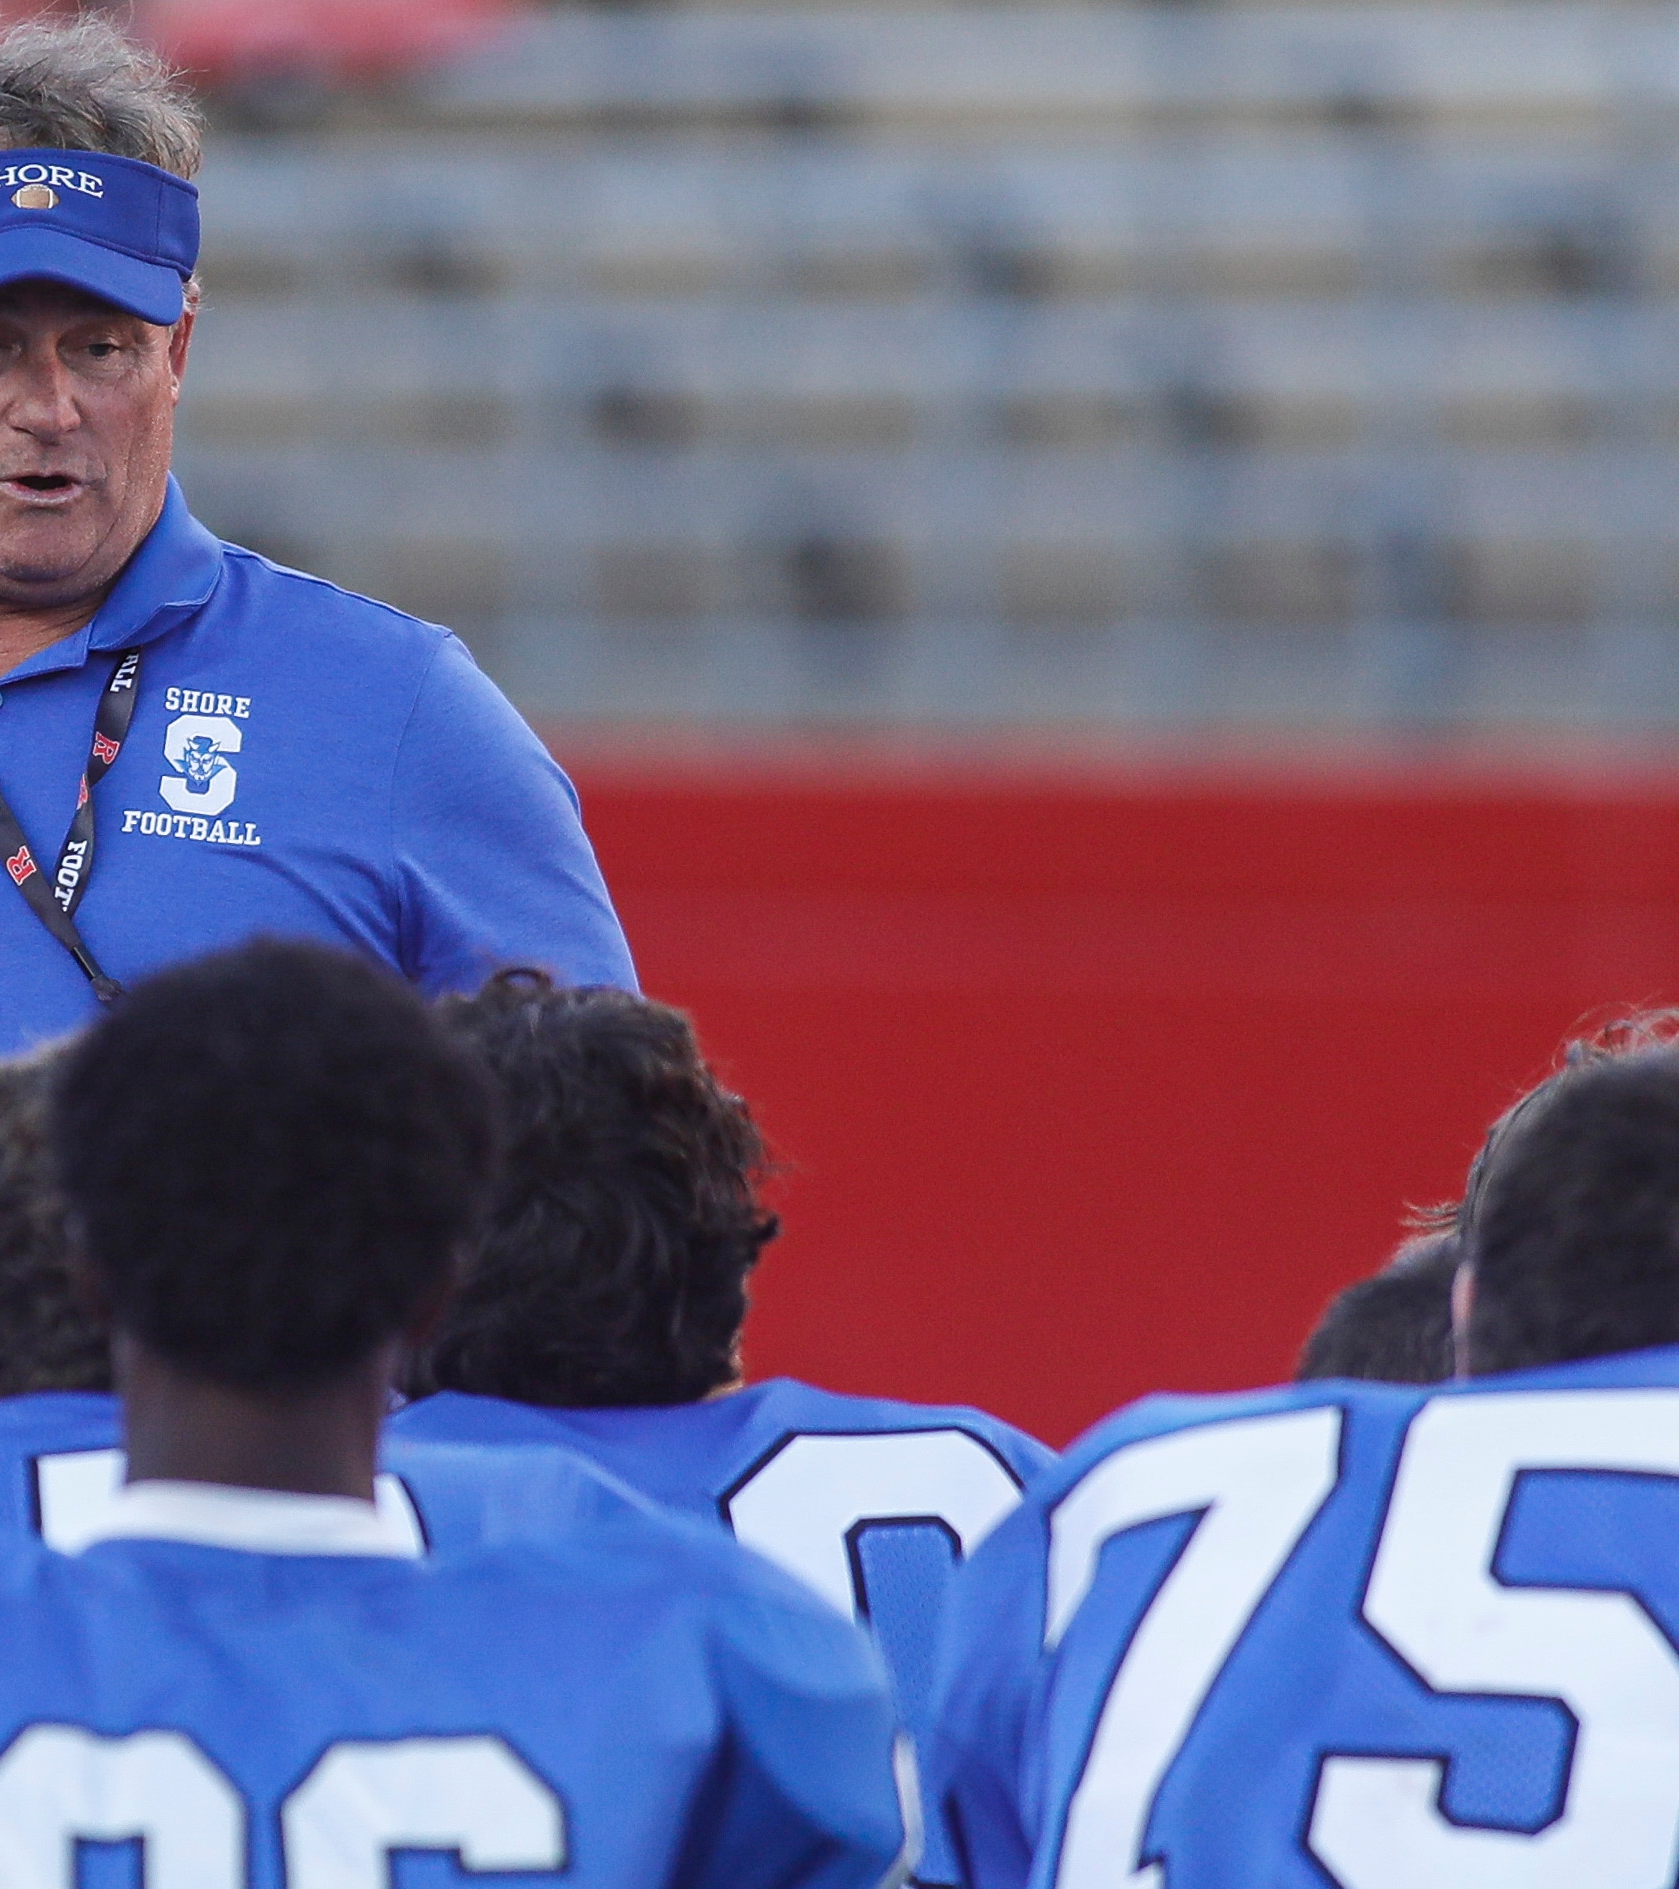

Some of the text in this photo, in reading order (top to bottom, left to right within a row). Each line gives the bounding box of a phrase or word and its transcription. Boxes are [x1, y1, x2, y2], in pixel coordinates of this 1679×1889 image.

[165, 687, 251, 718] SHORE
[92, 731, 120, 765] R
[159, 714, 242, 816] S
[121, 810, 261, 846] FOOTBALL
[6, 845, 37, 886] R
[54, 840, 87, 912] FOOT
